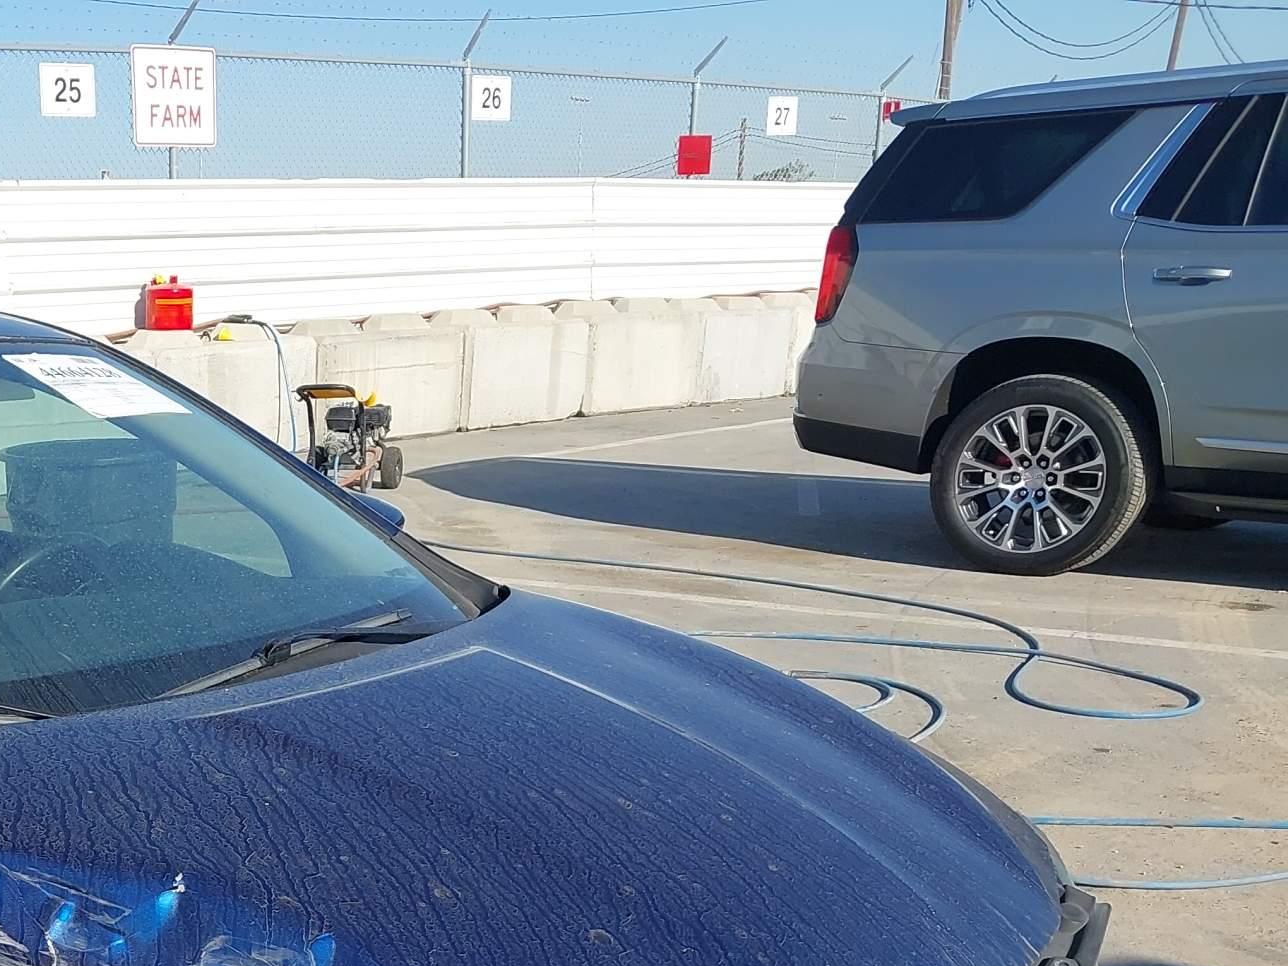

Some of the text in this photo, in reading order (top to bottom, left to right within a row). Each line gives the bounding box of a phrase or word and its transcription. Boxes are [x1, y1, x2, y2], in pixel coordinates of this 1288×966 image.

[55, 77, 81, 103] 25
[145, 65, 204, 90] STATE
[482, 87, 502, 109] 26
[150, 104, 202, 129] FARM
[774, 107, 790, 126] 27
